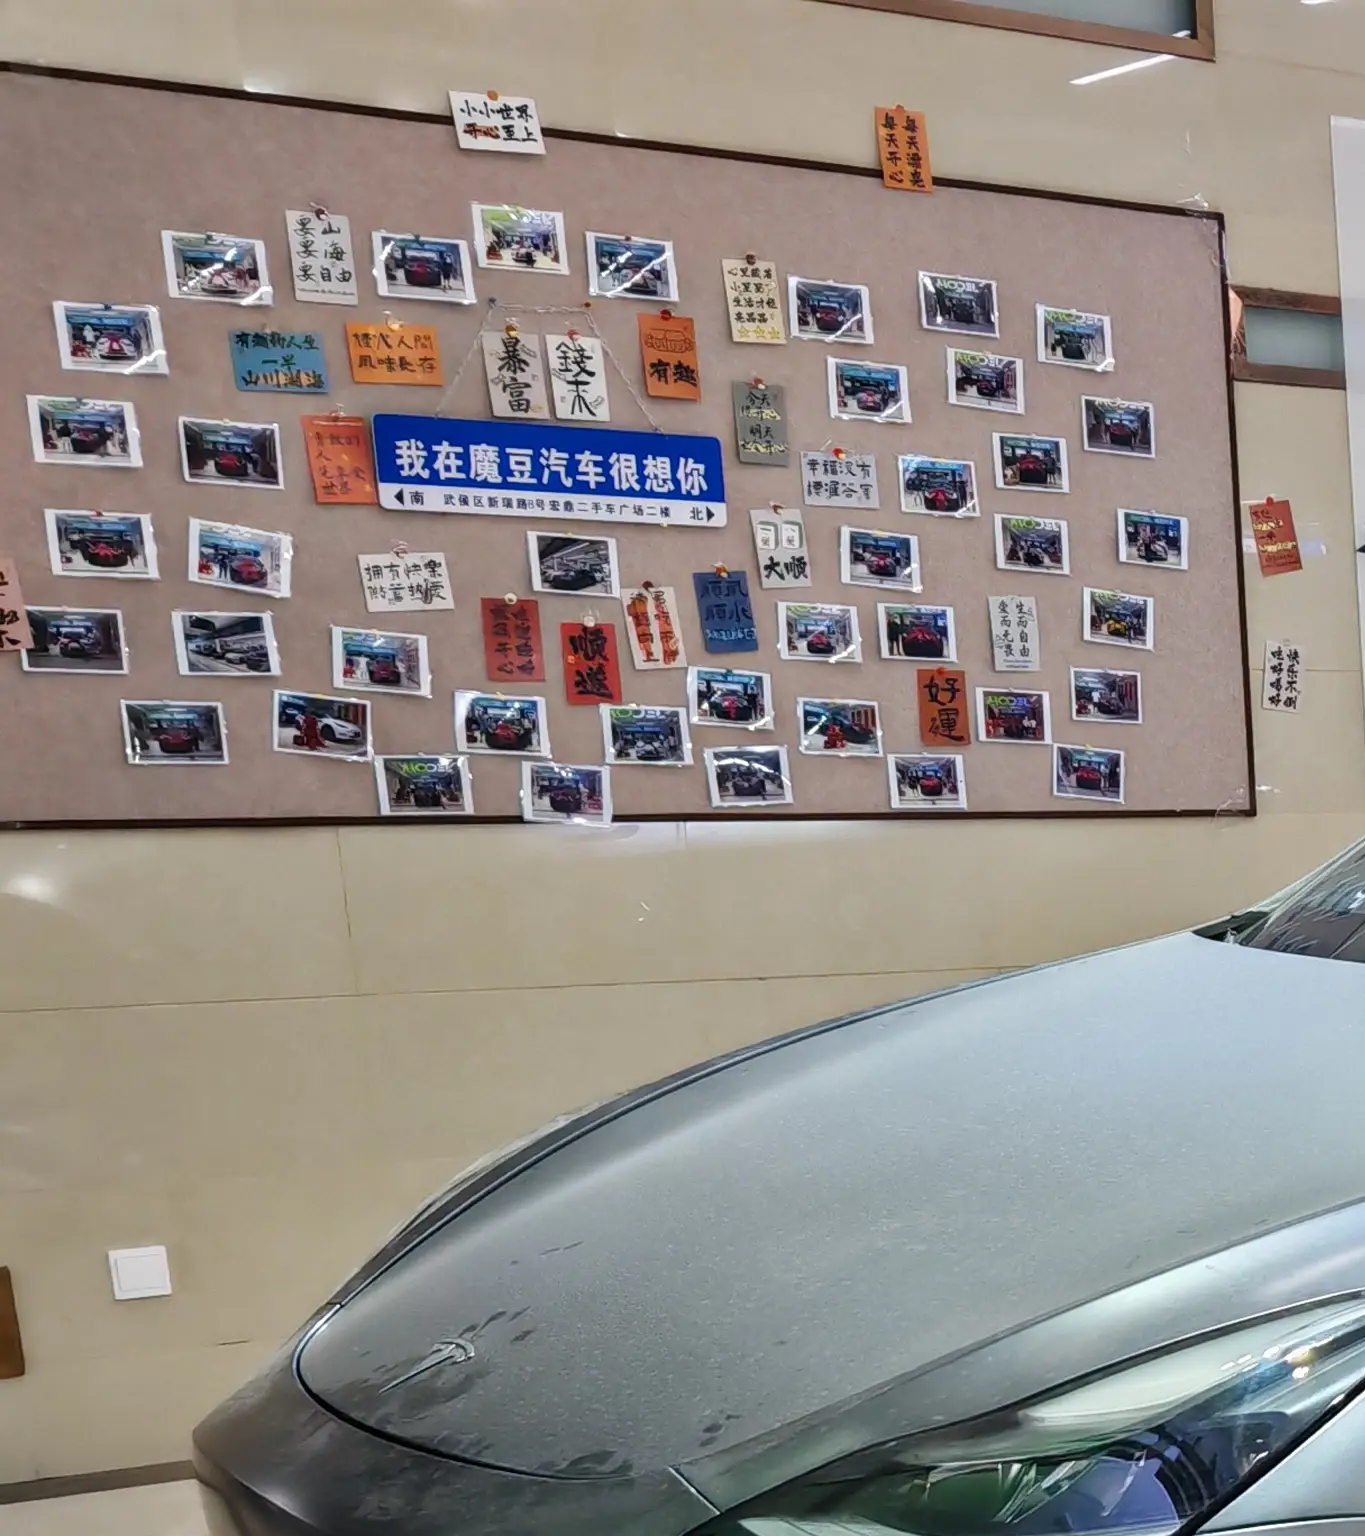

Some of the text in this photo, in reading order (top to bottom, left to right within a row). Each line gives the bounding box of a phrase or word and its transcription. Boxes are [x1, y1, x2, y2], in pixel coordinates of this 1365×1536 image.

[395, 438, 709, 496] 我在魔豆汽车很想你
[409, 491, 425, 506] 南
[690, 507, 704, 521] 北
